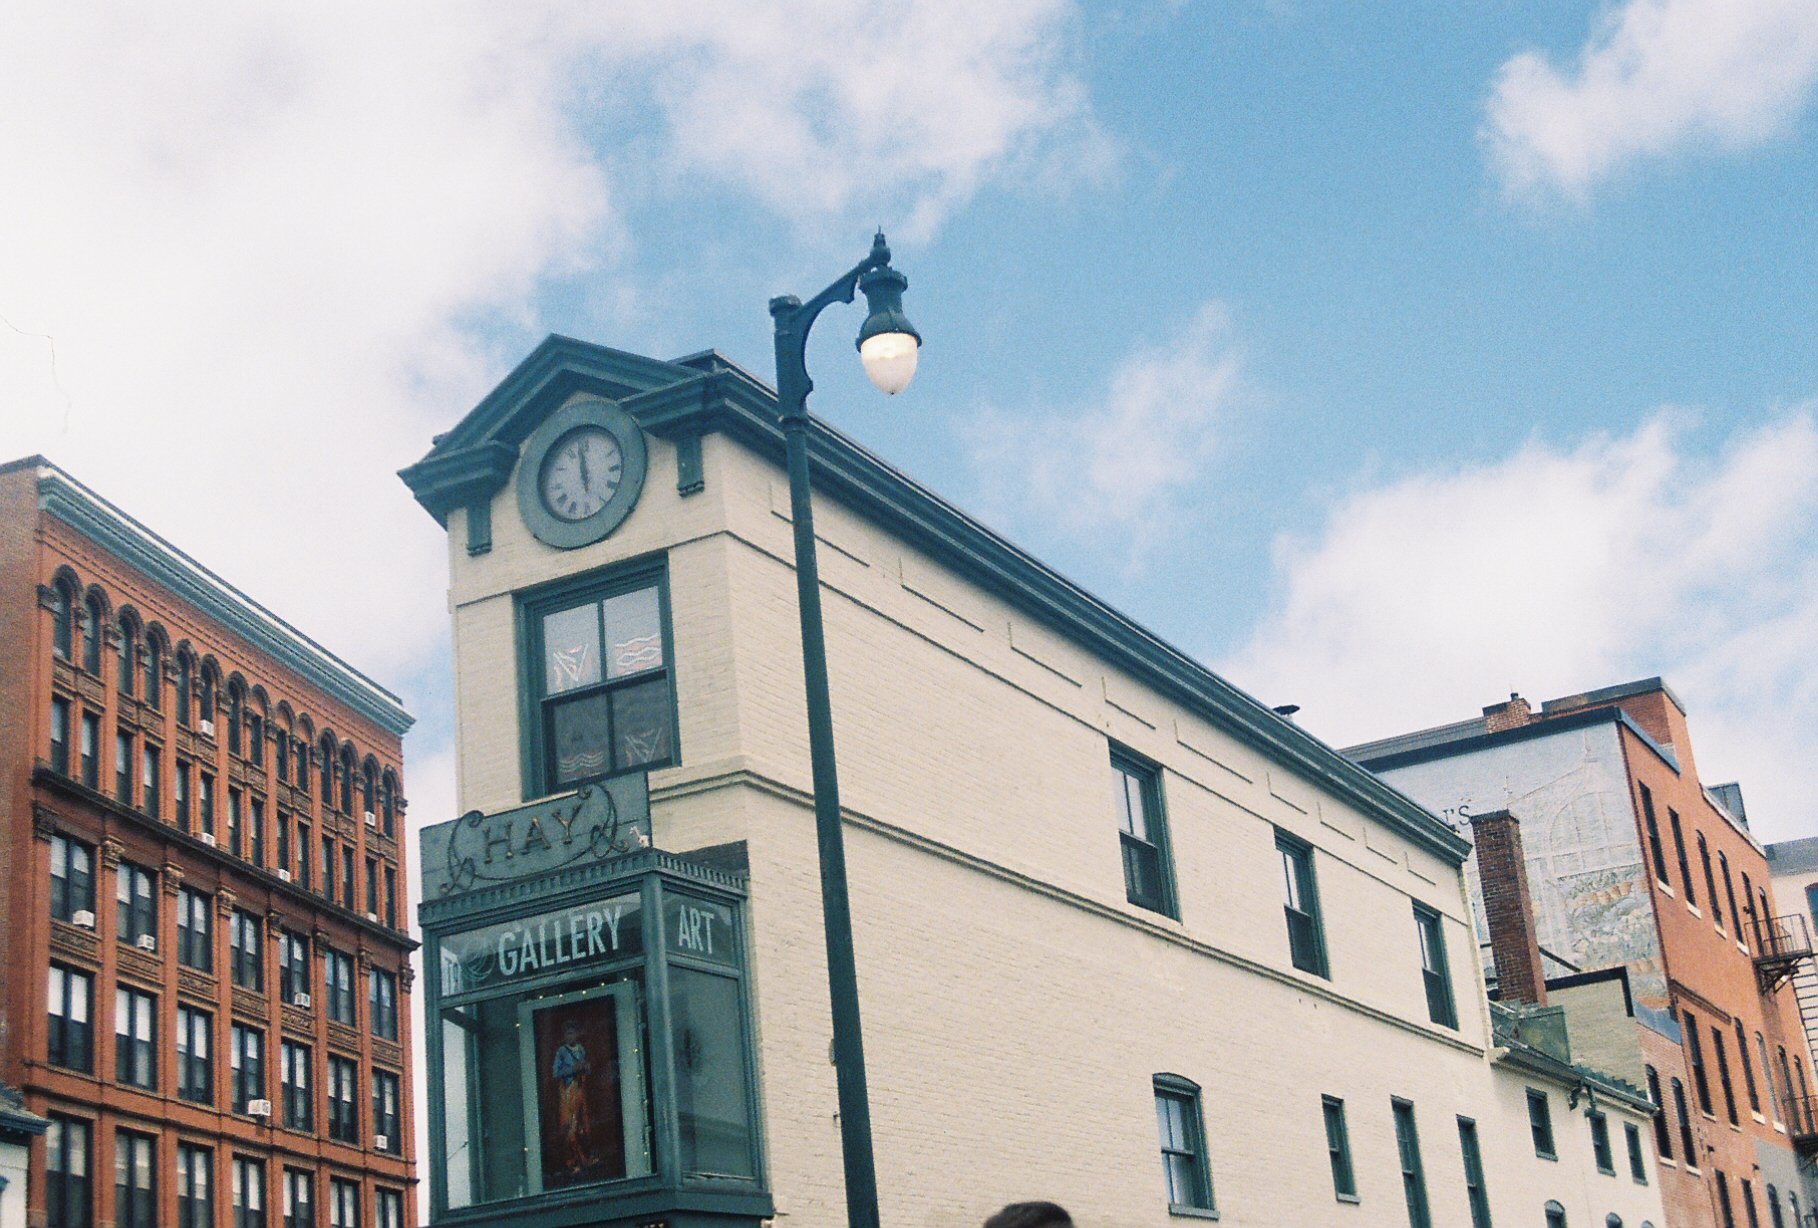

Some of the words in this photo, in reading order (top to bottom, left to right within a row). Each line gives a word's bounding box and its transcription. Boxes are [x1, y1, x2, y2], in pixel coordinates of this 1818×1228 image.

[482, 802, 583, 865] HAY
[498, 905, 622, 976] GALLERY
[678, 904, 715, 955] ART
